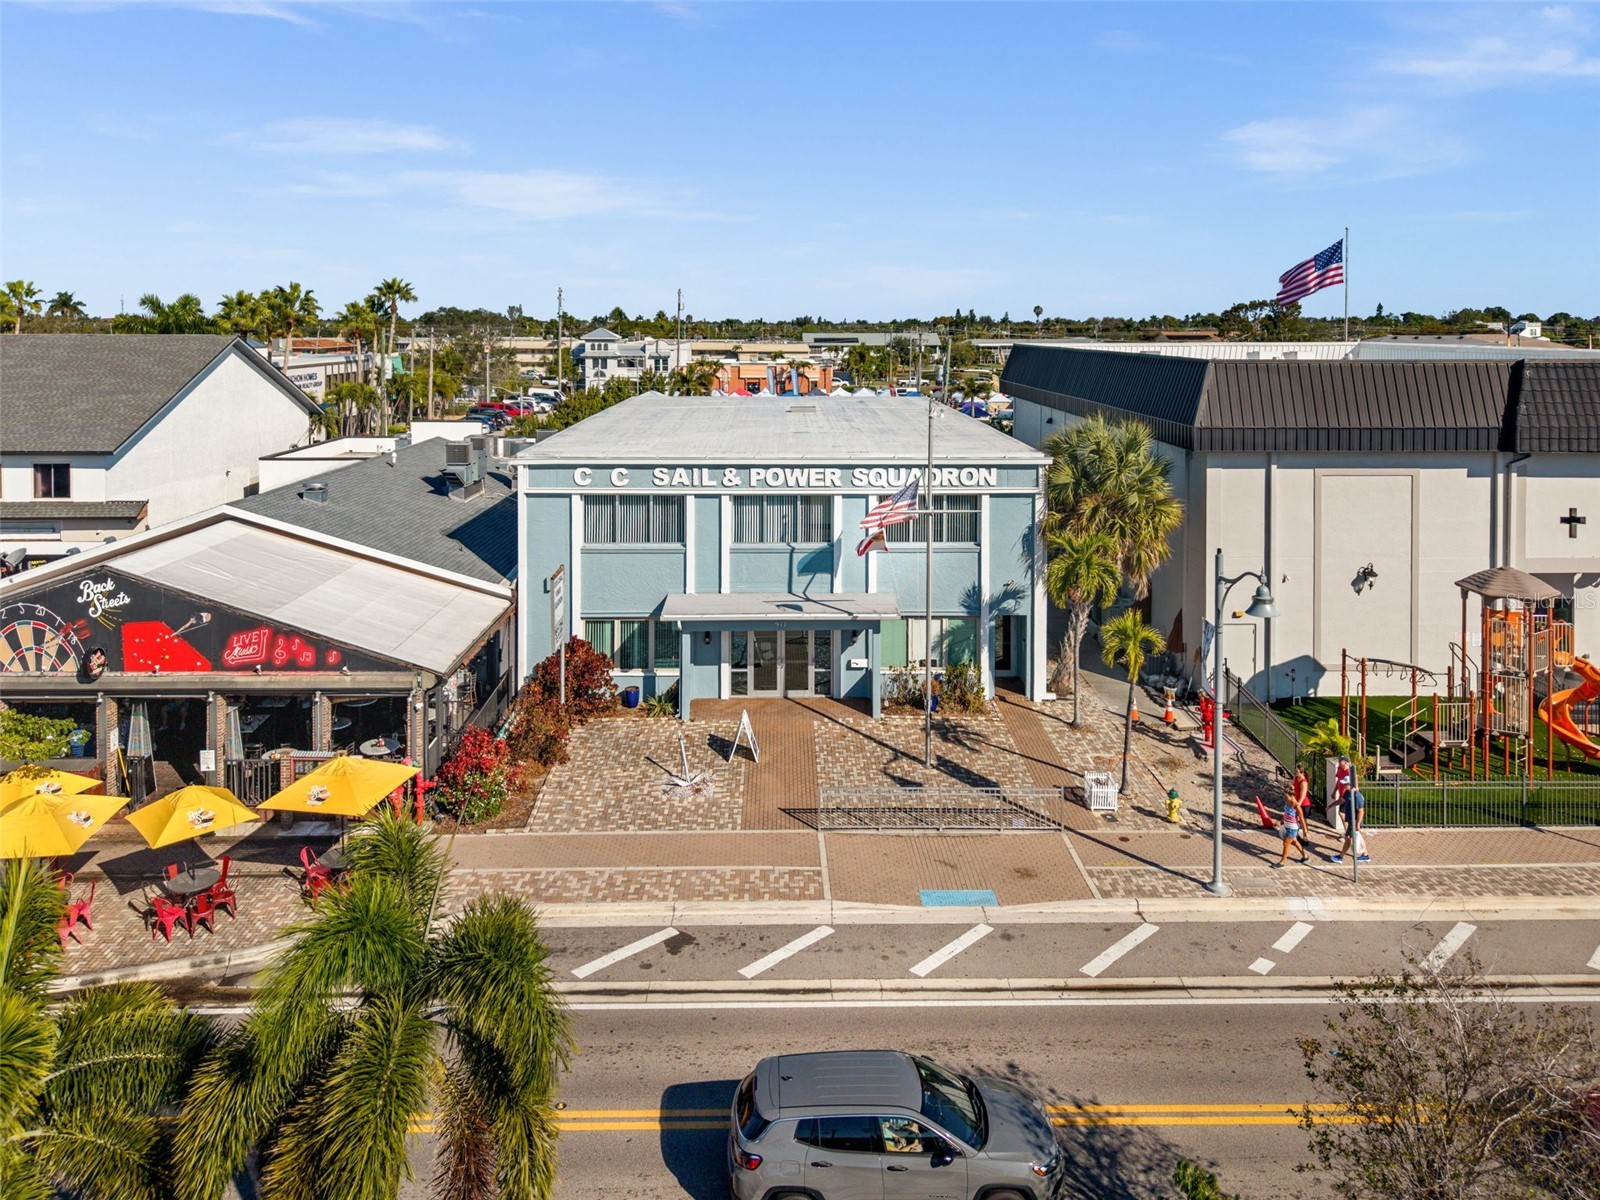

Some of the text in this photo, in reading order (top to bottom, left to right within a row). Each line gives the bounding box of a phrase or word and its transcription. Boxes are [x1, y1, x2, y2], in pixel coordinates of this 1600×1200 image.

[573, 467, 998, 488] C C SAIL & POWER SQUADRON
[77, 577, 116, 603] Back
[88, 591, 131, 617] Streets
[233, 631, 260, 647] LIVE
[224, 643, 259, 660] Music
